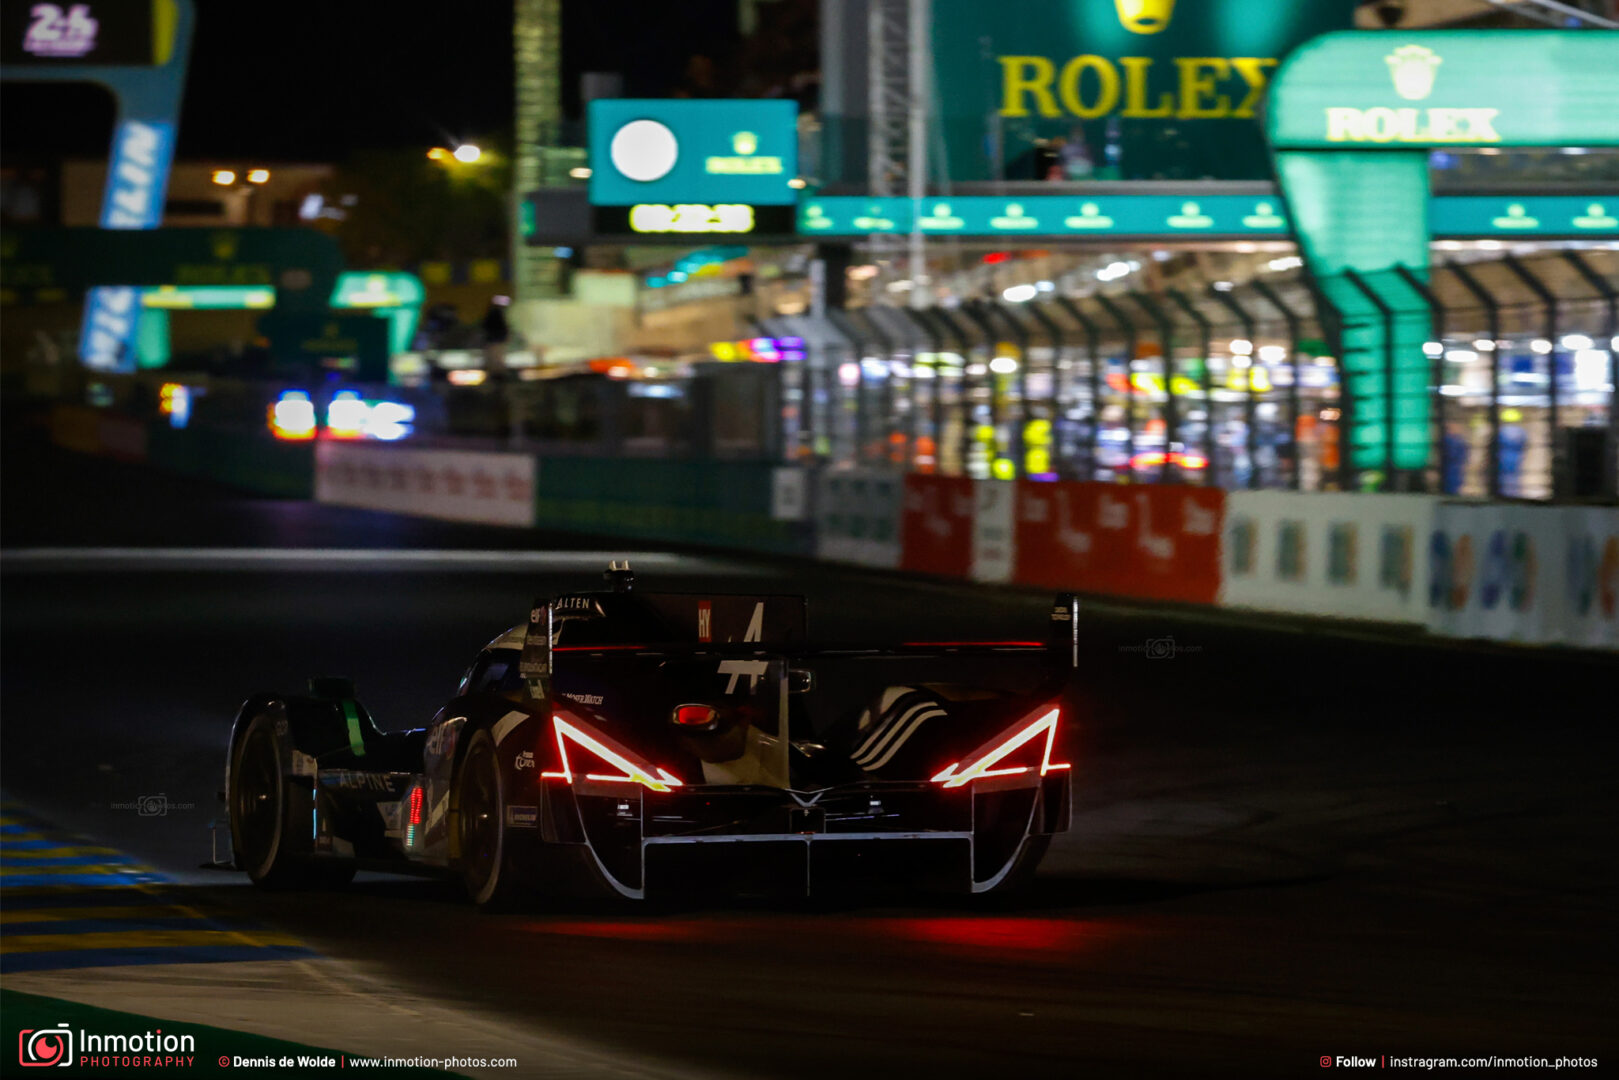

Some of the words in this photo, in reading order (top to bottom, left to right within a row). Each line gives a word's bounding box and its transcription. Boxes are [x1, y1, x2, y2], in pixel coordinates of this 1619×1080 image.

[999, 54, 1277, 119] ROLEX
[1325, 107, 1501, 143] ROLEX
[556, 598, 591, 610] ALTEN
[338, 772, 396, 793] ALPINE
